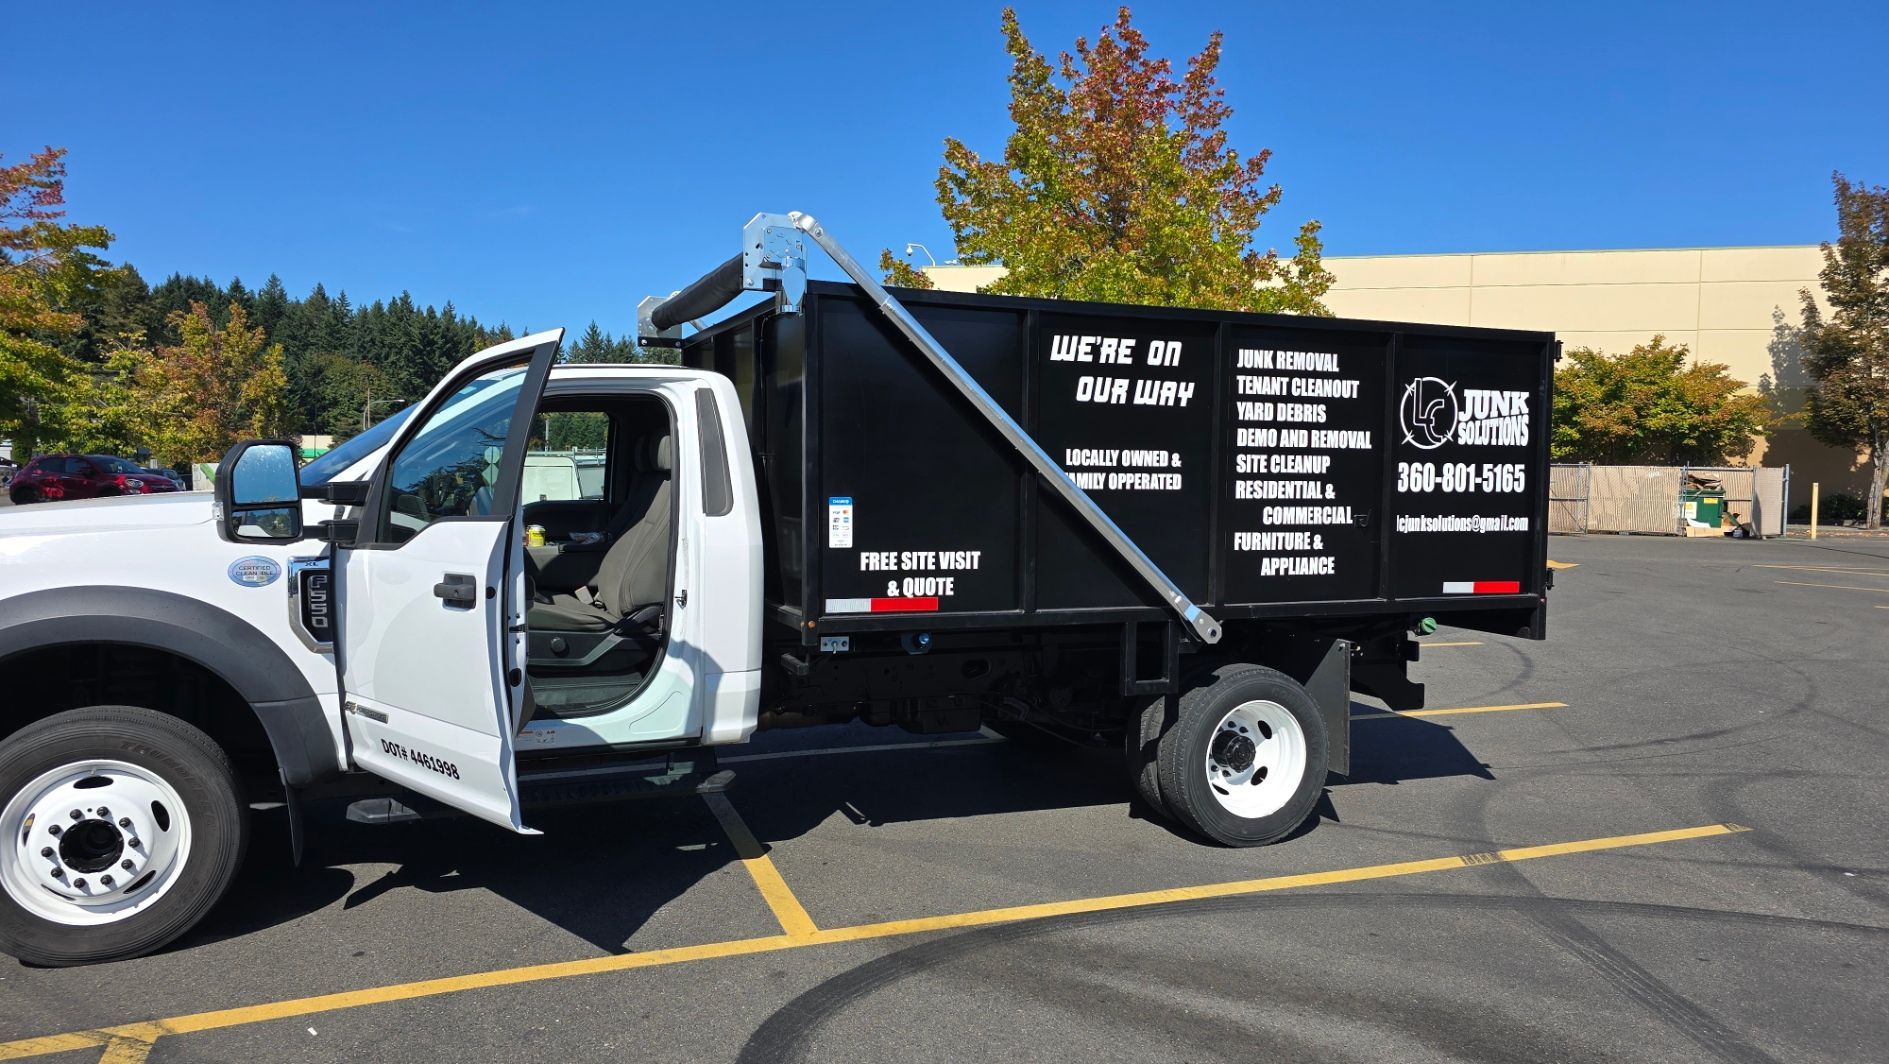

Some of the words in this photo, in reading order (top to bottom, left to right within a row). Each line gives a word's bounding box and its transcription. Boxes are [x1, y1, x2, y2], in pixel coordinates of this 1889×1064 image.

[1050, 335, 1136, 364] WE'RE
[1147, 340, 1182, 366] ON
[1237, 349, 1274, 369] JUNK
[1276, 351, 1339, 372] REMOVAL
[1076, 376, 1129, 404] OUR
[1133, 380, 1195, 407] WAY
[1236, 375, 1289, 396] TENANT
[1291, 377, 1359, 398] CLEANOUT
[1237, 402, 1274, 421] YARD
[1276, 403, 1327, 423] DEBRIS
[1458, 389, 1529, 422] JUNK
[1236, 428, 1277, 447] DEMO
[1280, 429, 1308, 448] AND
[1310, 430, 1372, 449] REMOVAL
[1458, 415, 1529, 446] SOLUTIONS
[1065, 449, 1119, 466] LOCALLY
[1121, 450, 1168, 467] OWNED
[1171, 453, 1182, 467] &
[1236, 454, 1267, 473] SITE
[1270, 455, 1331, 474] CLEANUP
[1108, 472, 1182, 490] OPPERATED
[1397, 462, 1525, 493] 360-801-5165
[1235, 480, 1322, 499] RESIDENTIAL
[1324, 483, 1336, 499] &
[1262, 506, 1353, 525] COMMERCIAL
[1396, 514, 1529, 534] lcjunksolutions@gmail.com
[1234, 532, 1311, 551] FURNITURE
[1312, 534, 1324, 549] &
[860, 552, 898, 571] FREE
[901, 552, 936, 571] SITE
[938, 551, 981, 570] VISIT
[1260, 557, 1335, 576] APPLIANCE
[887, 580, 899, 597] &
[903, 577, 954, 598] QUOTE
[380, 738, 408, 761] DOT#
[410, 749, 461, 781] 4461998
